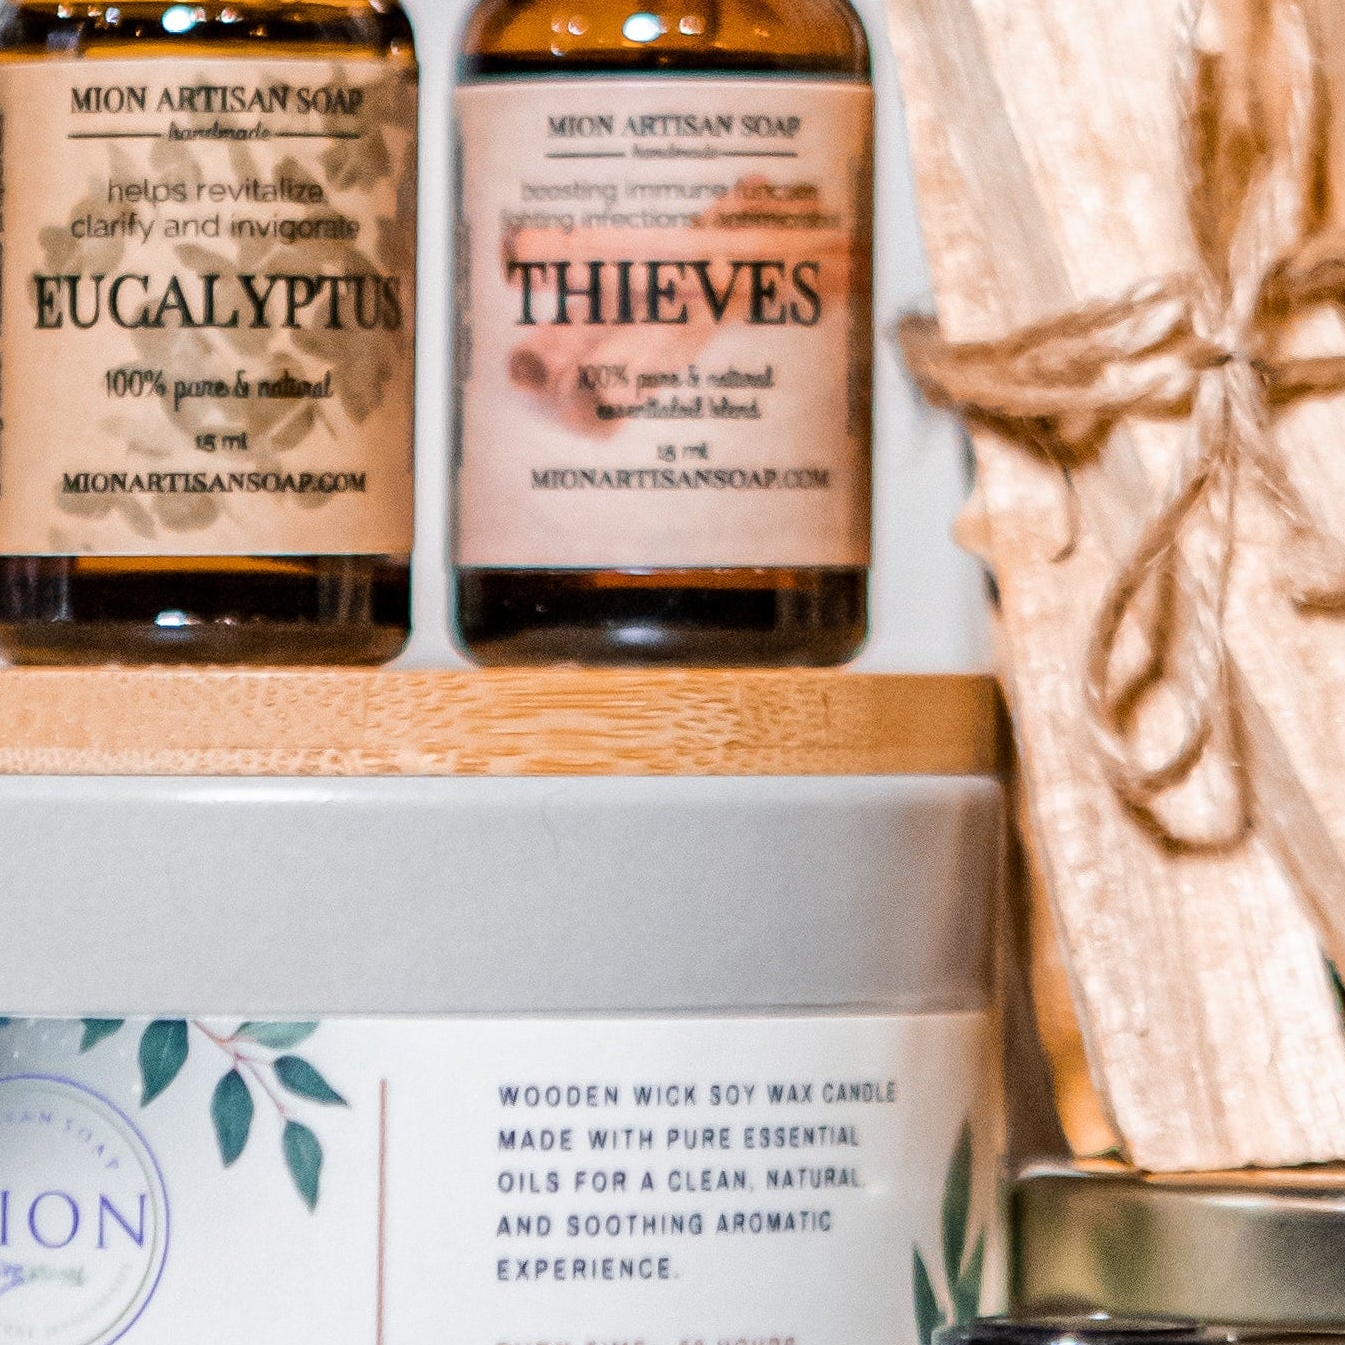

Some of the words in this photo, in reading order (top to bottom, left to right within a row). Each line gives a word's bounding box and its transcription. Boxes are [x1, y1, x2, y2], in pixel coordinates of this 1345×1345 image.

[70, 86, 147, 113] MION
[156, 85, 291, 113] ARTISAN
[296, 87, 363, 115] SOAP
[548, 115, 613, 139] MION
[623, 114, 732, 138] ARTISAN
[741, 115, 802, 138] SOAP
[108, 178, 187, 211] helps
[197, 178, 324, 204] revitalize
[521, 179, 618, 207] boosting
[625, 181, 728, 202] immune
[71, 213, 153, 244] clarify
[164, 214, 219, 238] and
[34, 274, 403, 330] EUCALYPTUS
[507, 259, 823, 326] THIEVES
[106, 370, 166, 397] 100%
[63, 472, 367, 493] MIONARTISANSOAP.COM
[498, 1084, 619, 1108] WOODEN
[633, 1083, 697, 1107] WICK
[709, 1083, 757, 1107] SOY
[766, 1082, 814, 1106] WAX
[821, 1079, 898, 1105] CANDLE
[497, 1128, 574, 1151] MADE
[587, 1127, 654, 1150] WITH
[666, 1126, 732, 1150] PURE
[742, 1124, 861, 1149] ESSENTIAL
[497, 1171, 560, 1194] OILS
[573, 1170, 627, 1193] FOR
[639, 1170, 655, 1193] A
[667, 1169, 754, 1194] CLEAN,
[496, 1214, 552, 1237] AND
[565, 1212, 705, 1237] SOOTHING
[715, 1210, 833, 1234] AROMATIC
[496, 1256, 680, 1281] EXPERIENCE.
